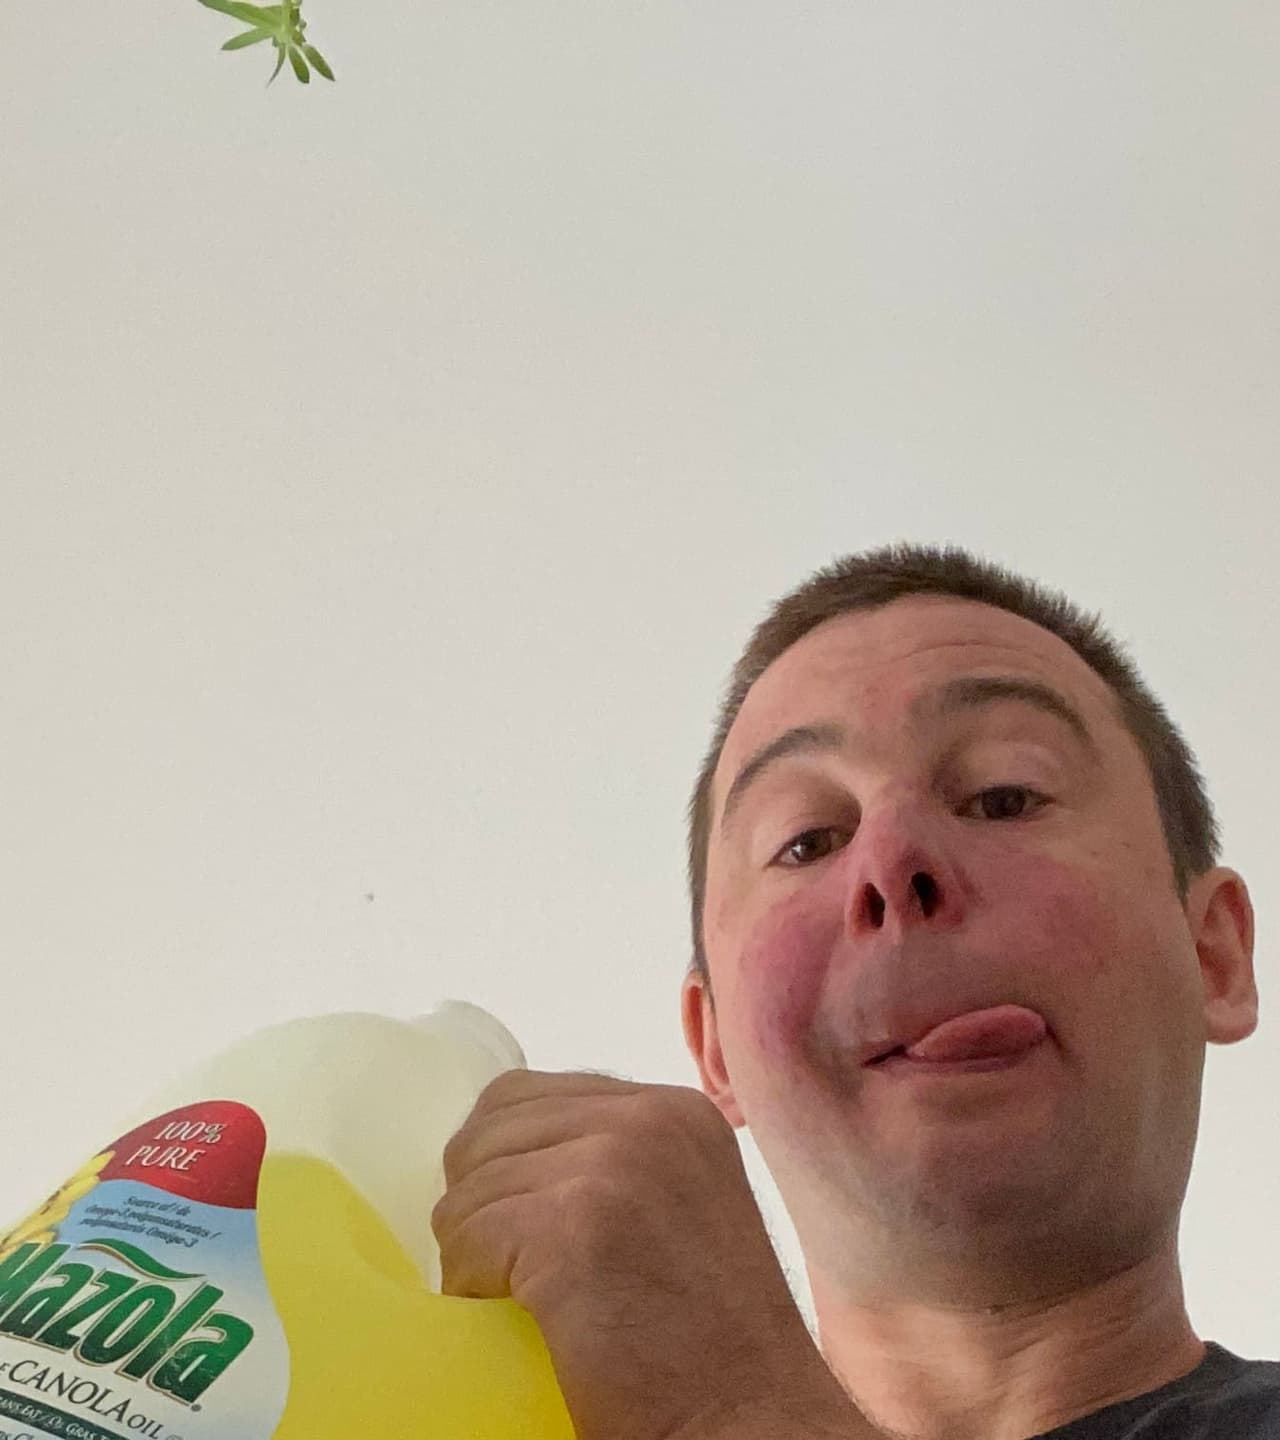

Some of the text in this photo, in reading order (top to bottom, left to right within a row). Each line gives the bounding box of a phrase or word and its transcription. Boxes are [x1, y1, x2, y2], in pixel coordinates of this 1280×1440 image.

[154, 1120, 227, 1144] 100%
[125, 1145, 207, 1171] PURE
[8, 1359, 133, 1425] CANOLA
[127, 1413, 164, 1440] OIL
